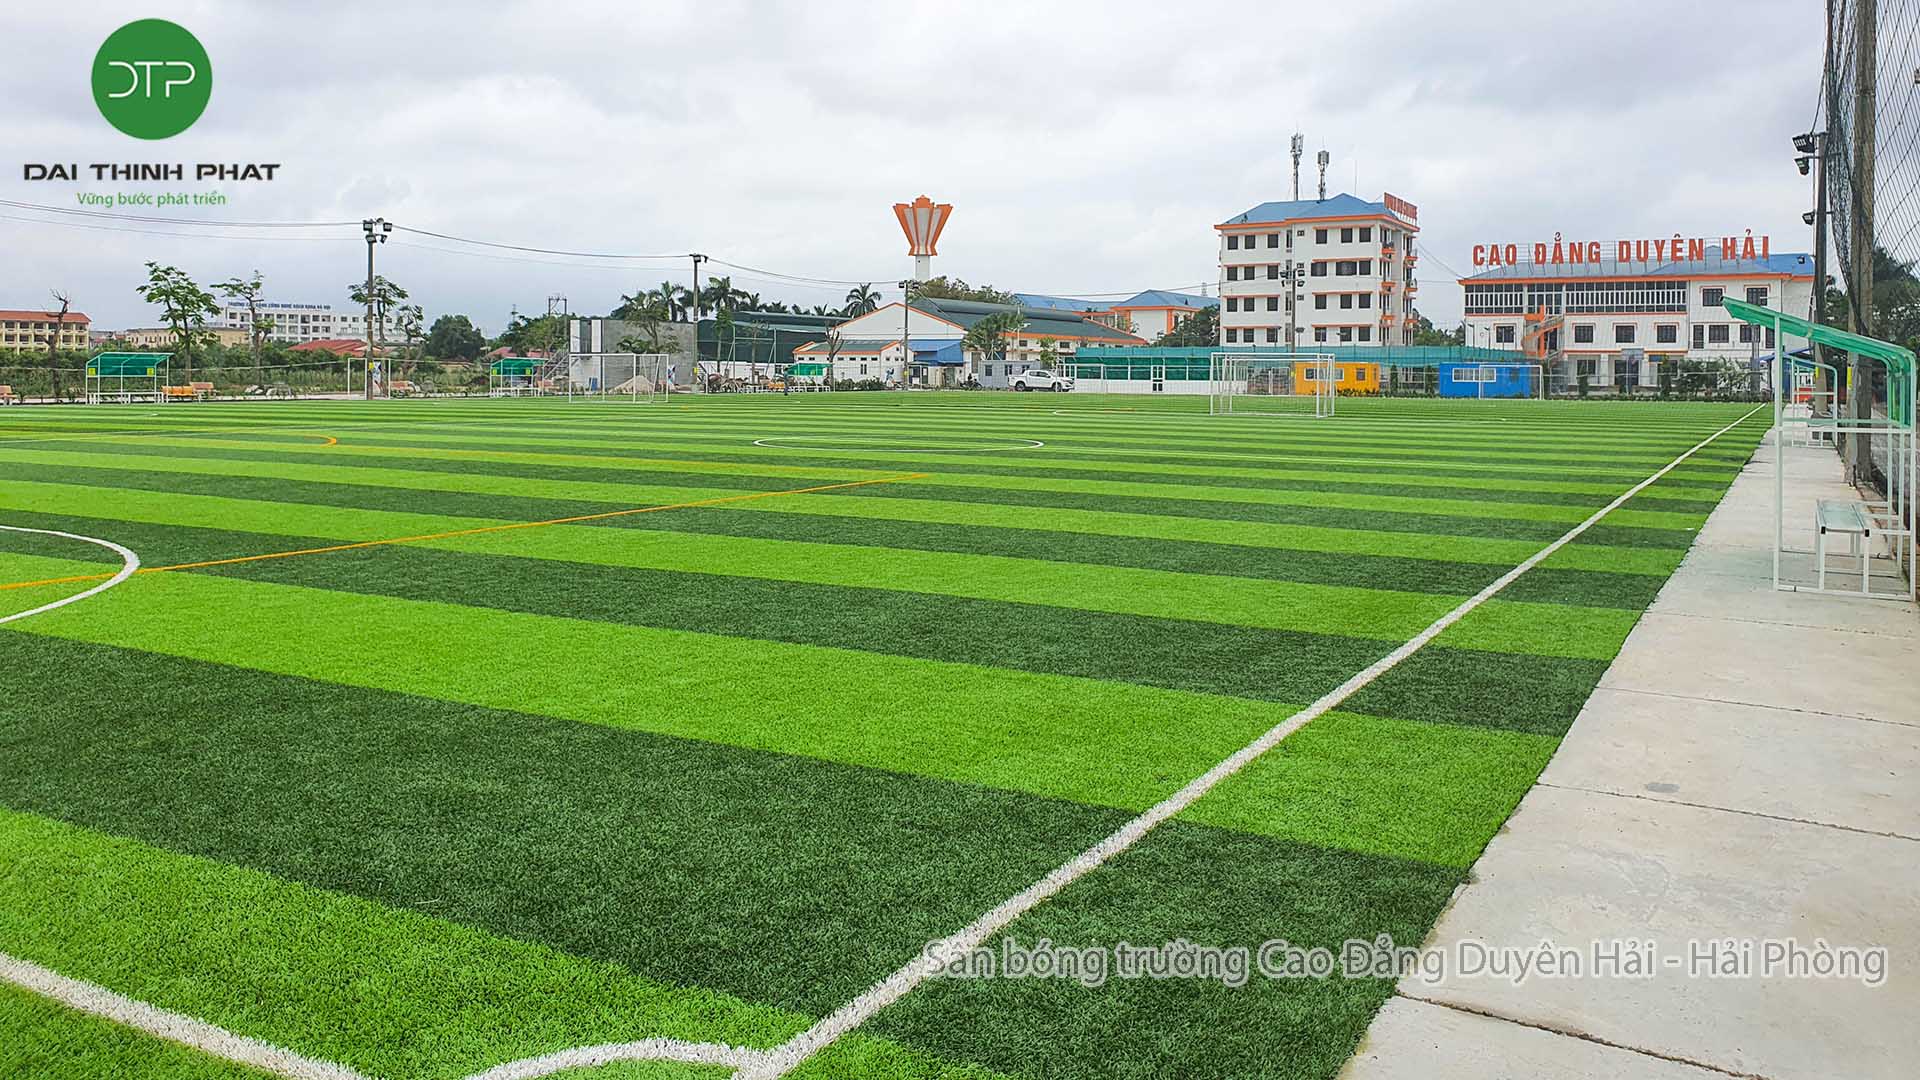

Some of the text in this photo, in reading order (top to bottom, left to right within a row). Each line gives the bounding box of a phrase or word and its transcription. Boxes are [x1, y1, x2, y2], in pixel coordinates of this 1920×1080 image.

[1472, 229, 1770, 266] CAO ĐẲNG DUYÊN HẢI
